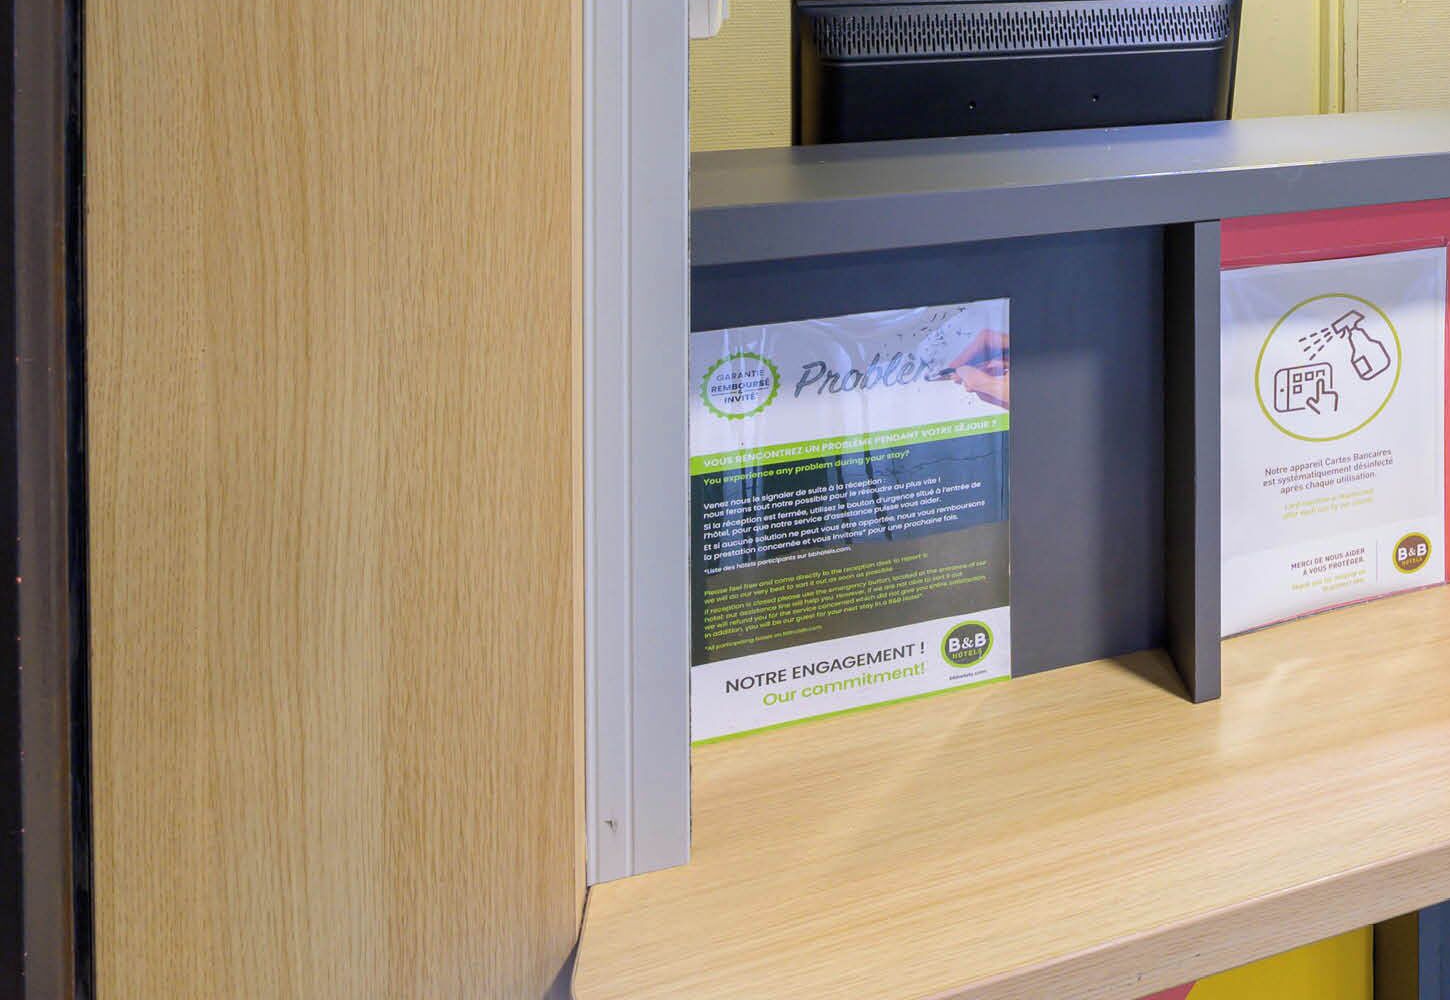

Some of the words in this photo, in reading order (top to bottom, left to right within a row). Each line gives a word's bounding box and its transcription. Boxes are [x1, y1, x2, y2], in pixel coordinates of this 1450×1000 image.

[711, 378, 770, 394] REMBOURSÉ
[716, 369, 765, 381] GARANTIE
[704, 456, 732, 468] VOUS
[735, 446, 800, 463] RENCONTREZ
[805, 444, 817, 453] UN
[821, 434, 873, 451] PROBLÈME
[876, 430, 917, 443] PENDANT
[921, 425, 953, 437] VOTRE
[956, 418, 989, 432] SÉJOUR
[704, 476, 720, 485] You
[723, 468, 775, 484] experience
[776, 467, 793, 477] any
[795, 460, 832, 474] problem
[834, 455, 863, 468] during
[865, 453, 884, 464] your
[886, 449, 909, 460] stay?
[1263, 478, 1275, 487] est
[1277, 462, 1351, 487] systématiquement
[1353, 455, 1392, 471] désinfecté
[1265, 464, 1287, 476] Notre
[1289, 458, 1322, 474] appareil
[1325, 453, 1351, 466] Cartes
[1353, 446, 1391, 461] Bancaires
[704, 500, 728, 510] Venez
[730, 498, 750, 506] nous
[752, 495, 759, 503] le
[761, 489, 794, 502] signaler
[795, 488, 805, 496] de
[808, 485, 827, 494] suite
[836, 482, 842, 490] la
[845, 476, 881, 490] réception
[704, 510, 724, 519] nous
[725, 505, 751, 515] ferons
[753, 502, 769, 511] tout
[771, 498, 793, 508] notre
[794, 493, 827, 506] possible
[829, 491, 847, 501] pour
[849, 488, 855, 496] le
[858, 483, 891, 495] résoudre
[905, 478, 921, 489] plus
[923, 476, 936, 485] vite
[1280, 481, 1303, 495] après
[1305, 476, 1334, 492] chaque
[704, 523, 711, 531] Si
[722, 515, 761, 529] réception
[777, 508, 808, 520] fermée,
[810, 503, 836, 514] utilisez
[846, 498, 874, 508] bouton
[876, 491, 914, 505] d'urgence
[916, 488, 933, 497] situé
[942, 483, 969, 493] l'entrée
[732, 527, 751, 536] pour
[753, 524, 768, 532] que
[770, 519, 792, 529] notre
[794, 514, 821, 525] service
[824, 506, 872, 520] d'assistance
[874, 502, 898, 513] puisse
[900, 500, 918, 508] vous
[920, 495, 941, 505] aider.
[704, 543, 711, 551] Et
[721, 538, 753, 548] aucune
[755, 531, 787, 542] solution
[800, 527, 818, 536] peut
[820, 524, 839, 532] vous
[841, 520, 856, 528] être
[897, 511, 915, 519] nous
[917, 508, 934, 516] vous
[936, 499, 984, 513] remboursons
[704, 553, 711, 561] la
[714, 546, 754, 560] prestation
[757, 539, 800, 552] concernée
[812, 535, 830, 543] vous
[867, 526, 885, 535] pour
[903, 515, 941, 529] prochaine
[944, 513, 958, 521] fois.
[1291, 558, 1312, 570] MERCI
[1314, 556, 1322, 564] DE
[1324, 552, 1343, 562] NOUS
[1344, 547, 1364, 557] AIDER
[1398, 542, 1427, 561] B&B
[1309, 564, 1326, 575] VOUS
[949, 631, 986, 653] B&B
[952, 647, 982, 659] HOTELS
[726, 668, 786, 693] NOTRE
[792, 643, 914, 680] ENGAGEMENT
[920, 641, 924, 654] !
[763, 687, 797, 707] Our
[801, 660, 924, 699] commitment!
